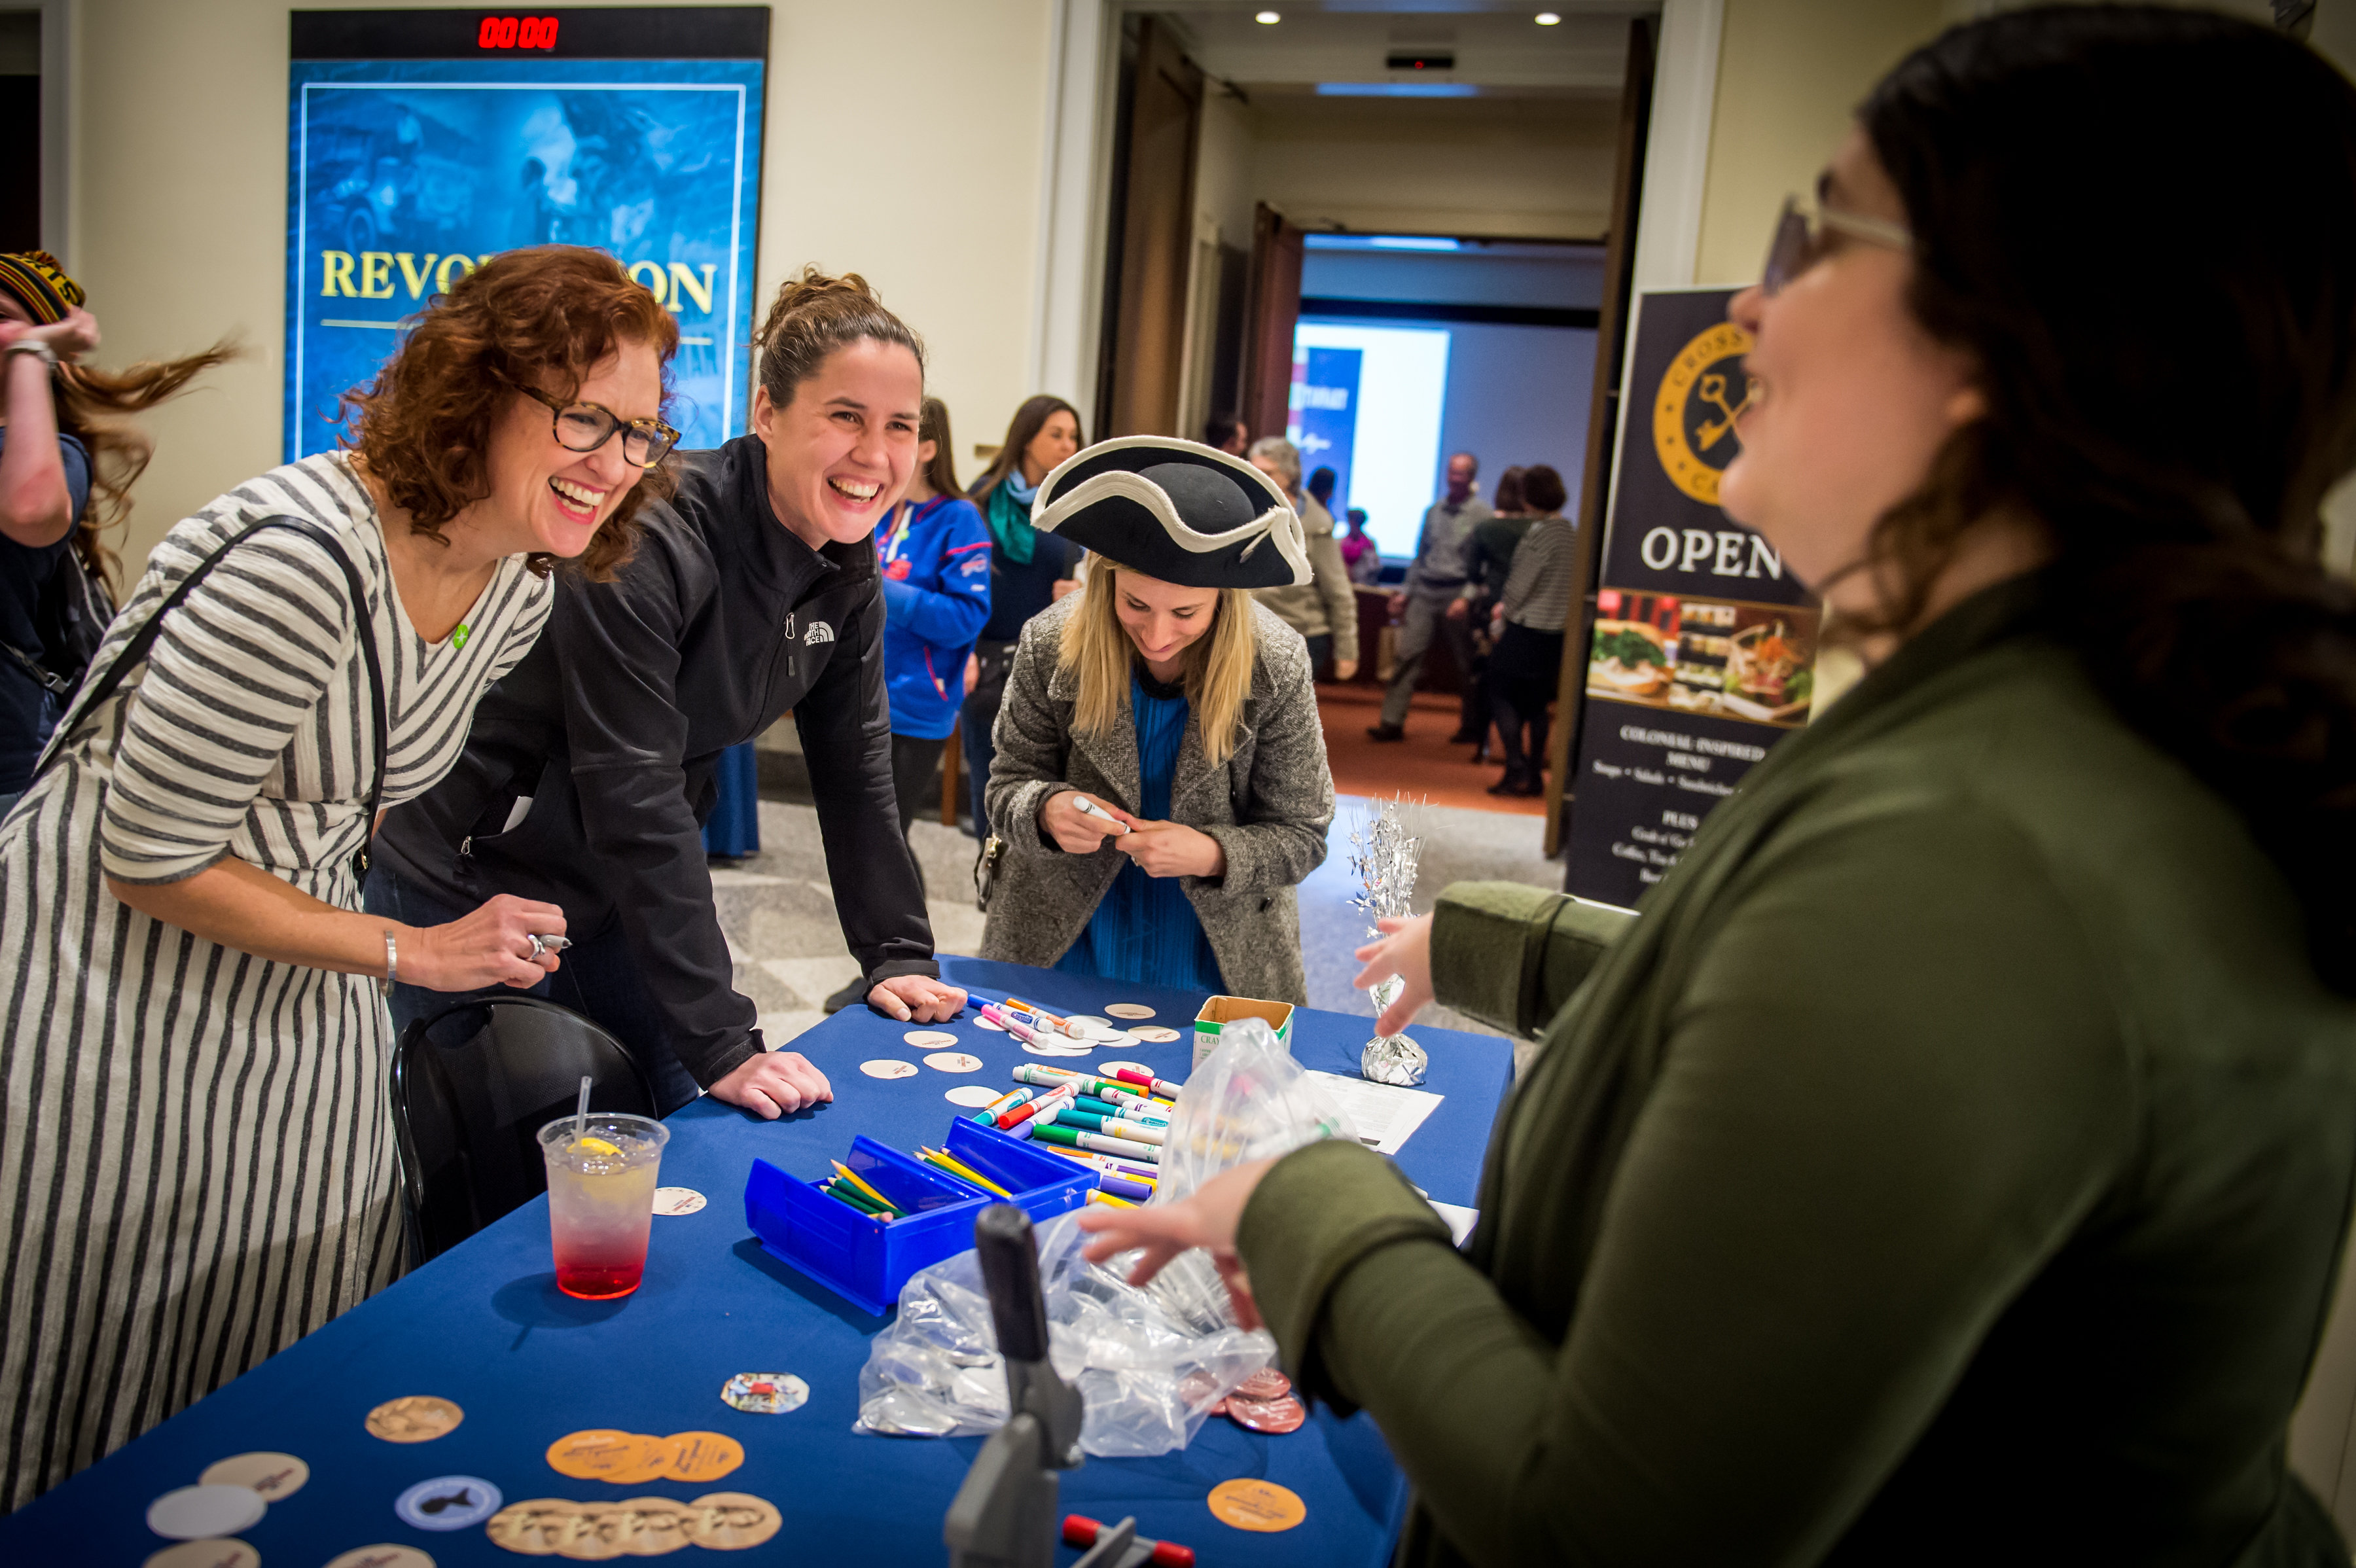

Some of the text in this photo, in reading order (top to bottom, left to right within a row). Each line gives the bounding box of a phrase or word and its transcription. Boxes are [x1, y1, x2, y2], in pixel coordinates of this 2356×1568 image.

[321, 250, 717, 315] REVOON
[1641, 526, 1783, 580] OPEN
[1662, 809, 1699, 831] PLUS
